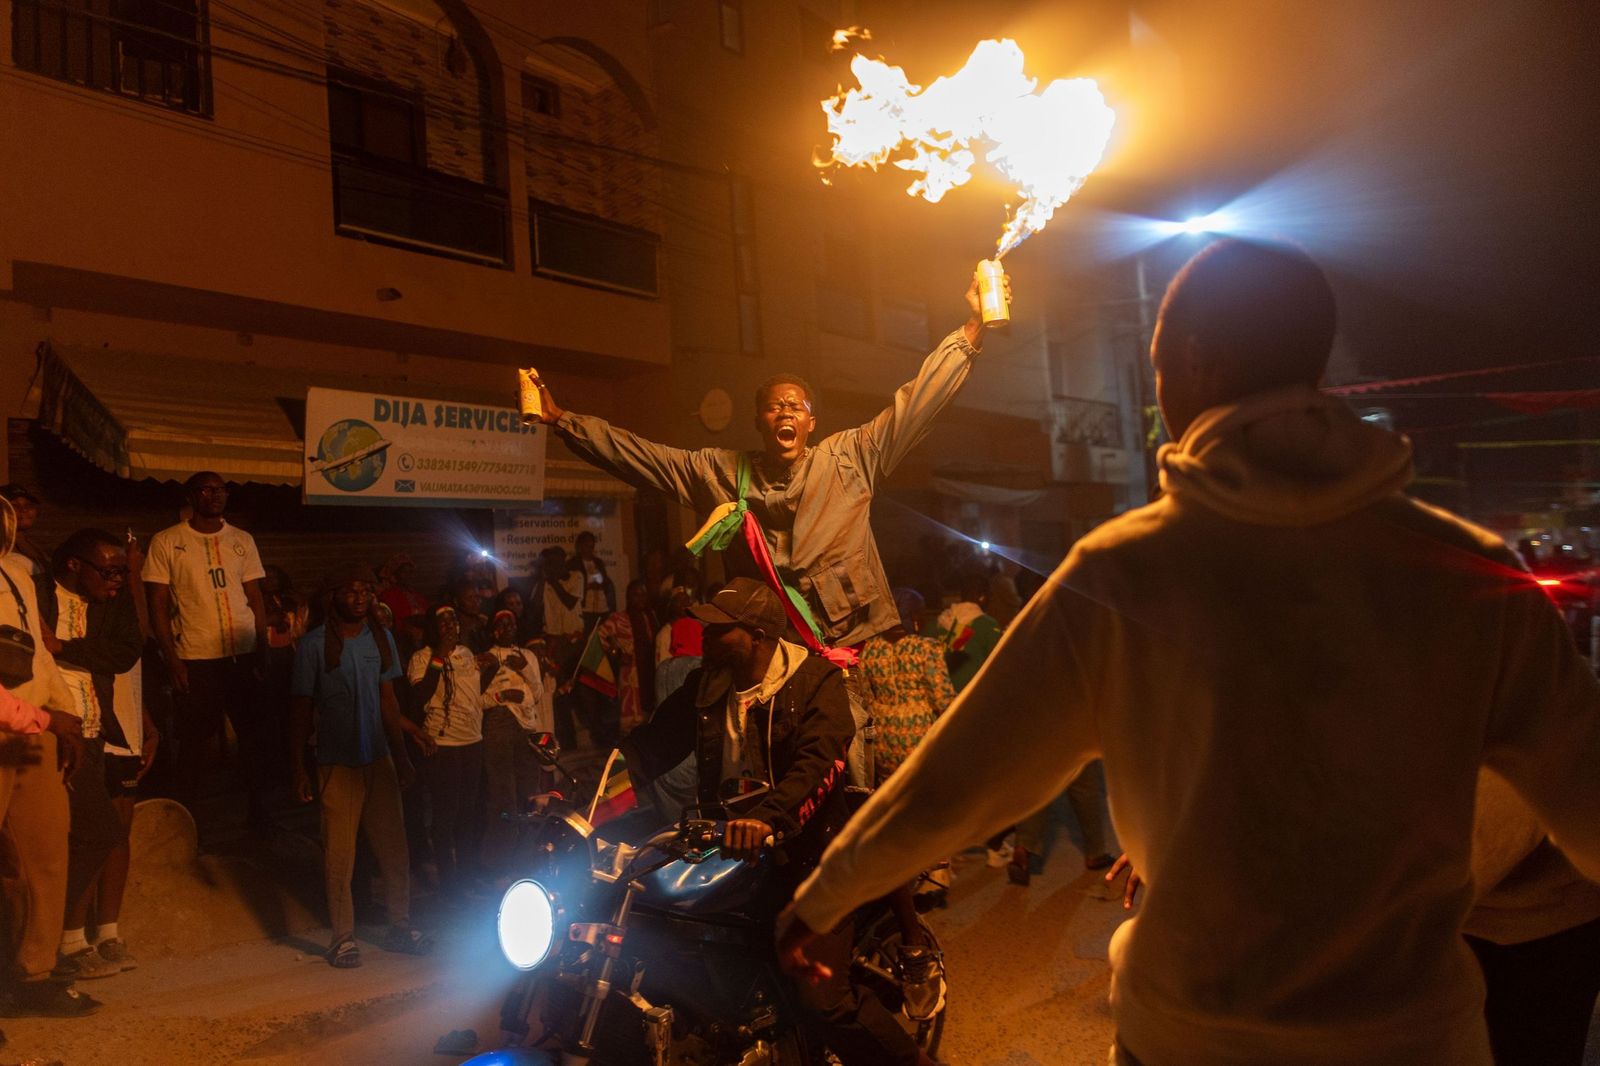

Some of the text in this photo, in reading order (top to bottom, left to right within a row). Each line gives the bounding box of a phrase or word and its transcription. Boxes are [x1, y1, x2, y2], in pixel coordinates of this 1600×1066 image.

[374, 398, 427, 428] DIJA
[510, 518, 566, 528] servation
[208, 568, 227, 589] 10
